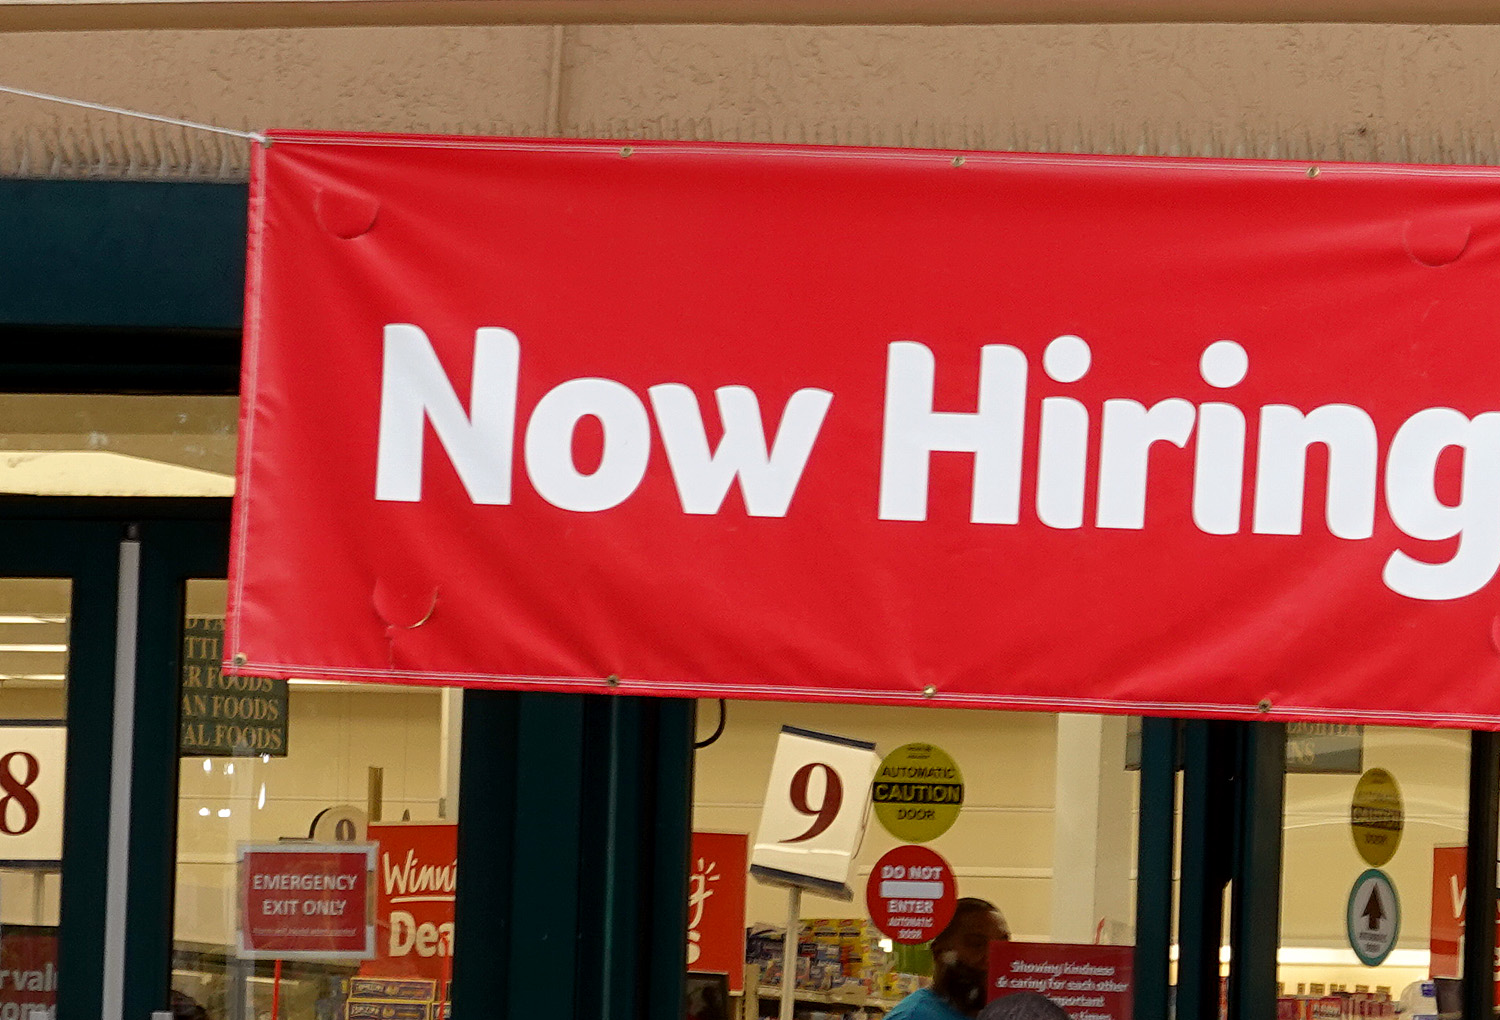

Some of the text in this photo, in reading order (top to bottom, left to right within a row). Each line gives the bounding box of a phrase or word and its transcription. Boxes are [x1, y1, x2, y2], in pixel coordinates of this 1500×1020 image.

[373, 322, 833, 518] Now
[211, 695, 279, 721] FOODS
[214, 724, 283, 749] FOODS
[882, 765, 956, 779] AUTOMATIC
[0, 751, 41, 837] 8
[777, 762, 844, 844] 9
[875, 784, 961, 803] CAUTION
[897, 807, 936, 821] DOOR
[253, 872, 358, 891] EMERGENCY
[881, 865, 944, 880] DO NOT
[262, 899, 347, 916] EXIT ONLY
[887, 899, 935, 914] ENTER
